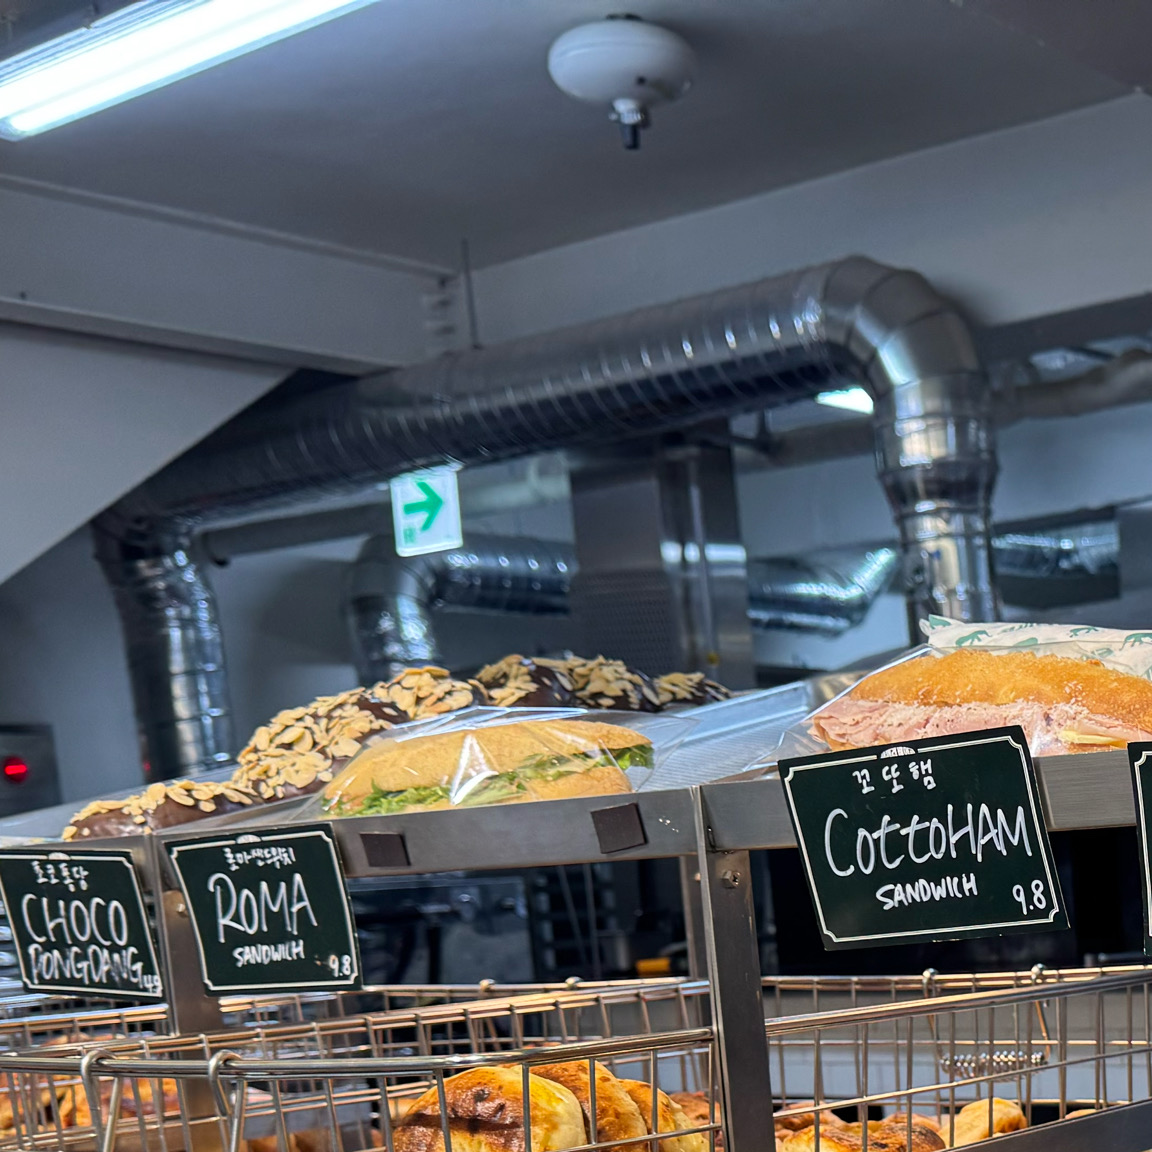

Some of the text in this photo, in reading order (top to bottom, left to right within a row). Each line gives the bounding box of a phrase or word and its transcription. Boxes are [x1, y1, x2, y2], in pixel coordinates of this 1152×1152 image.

[206, 872, 319, 944] ROMA
[875, 872, 979, 911] SANDWICH
[1011, 879, 1047, 916] 9.8
[21, 893, 129, 947] CHOCO
[232, 939, 306, 968] SANDWICH
[328, 954, 352, 978] 9.8
